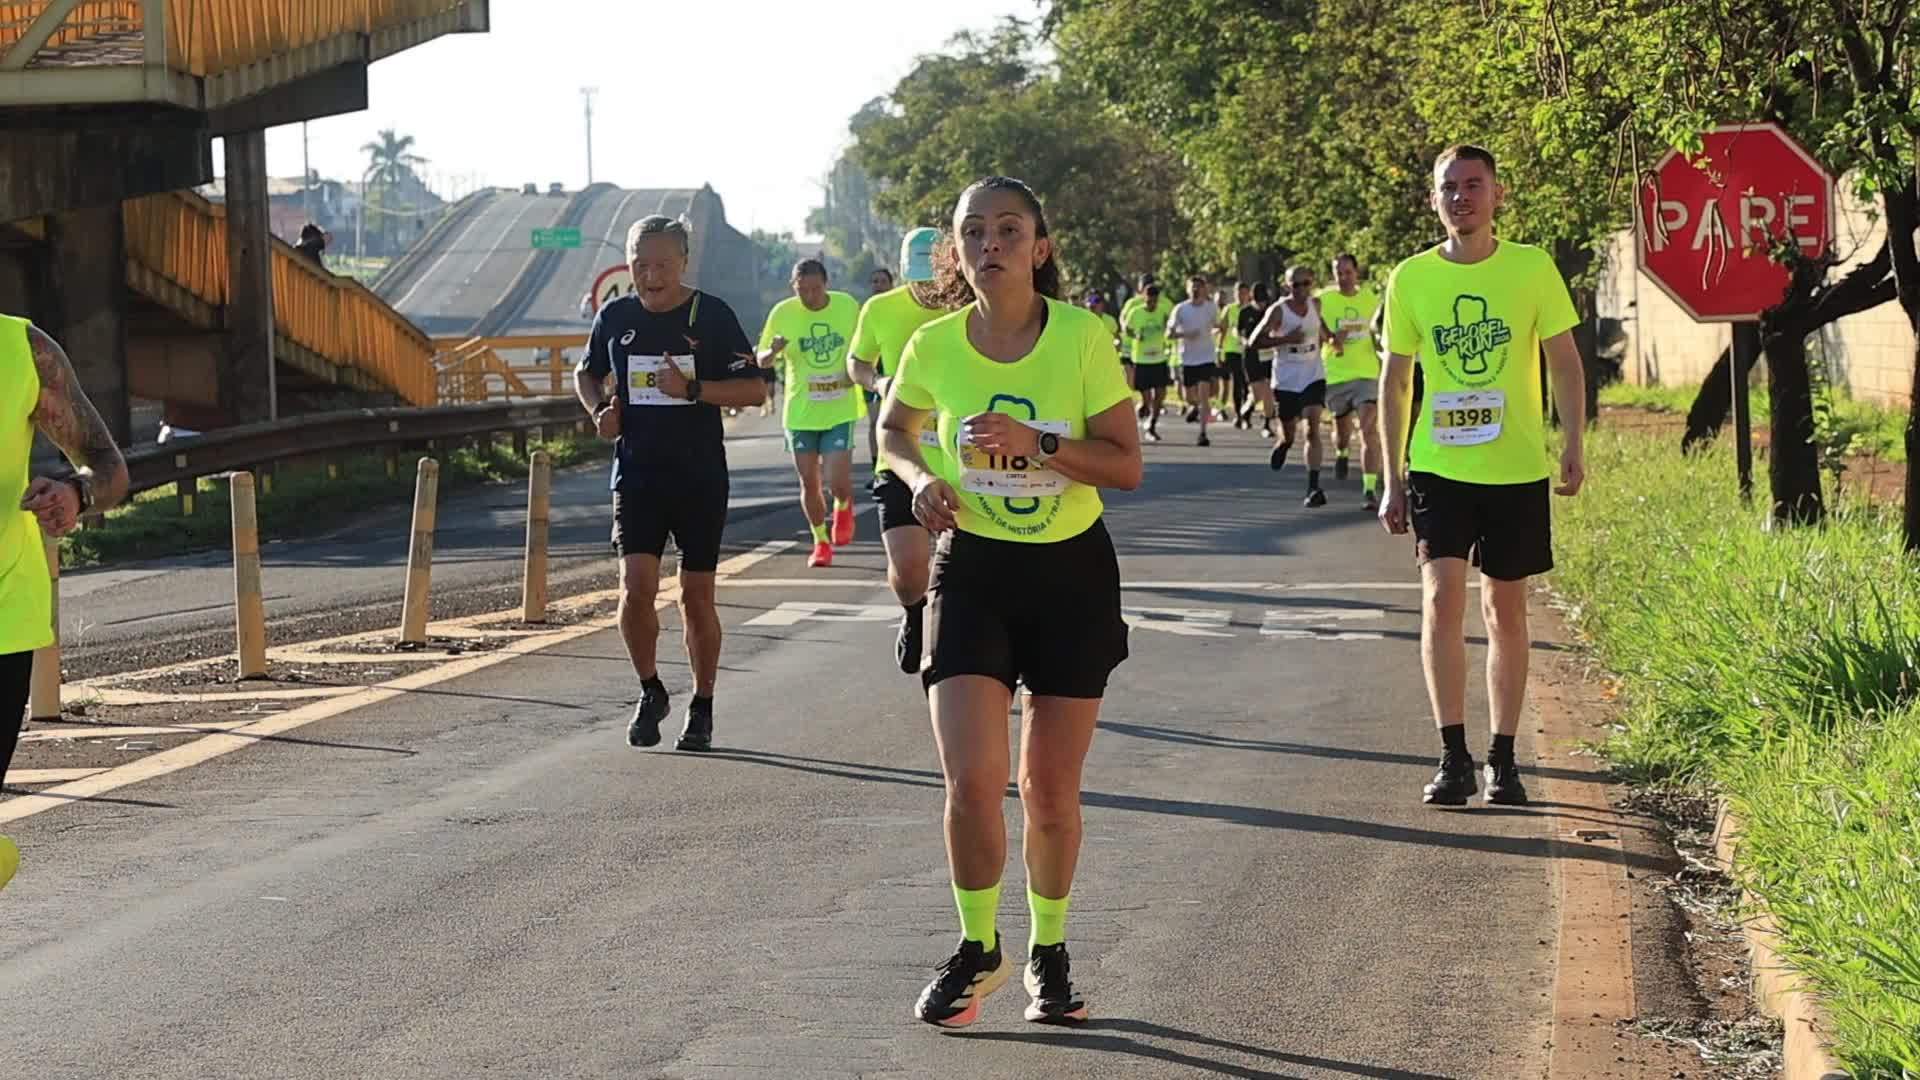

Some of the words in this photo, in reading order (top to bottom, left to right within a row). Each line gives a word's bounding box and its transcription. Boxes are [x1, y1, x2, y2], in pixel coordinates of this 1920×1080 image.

[1653, 195, 1817, 252] PARE
[1459, 334, 1492, 357] RUN
[1448, 408, 1492, 427] 1398
